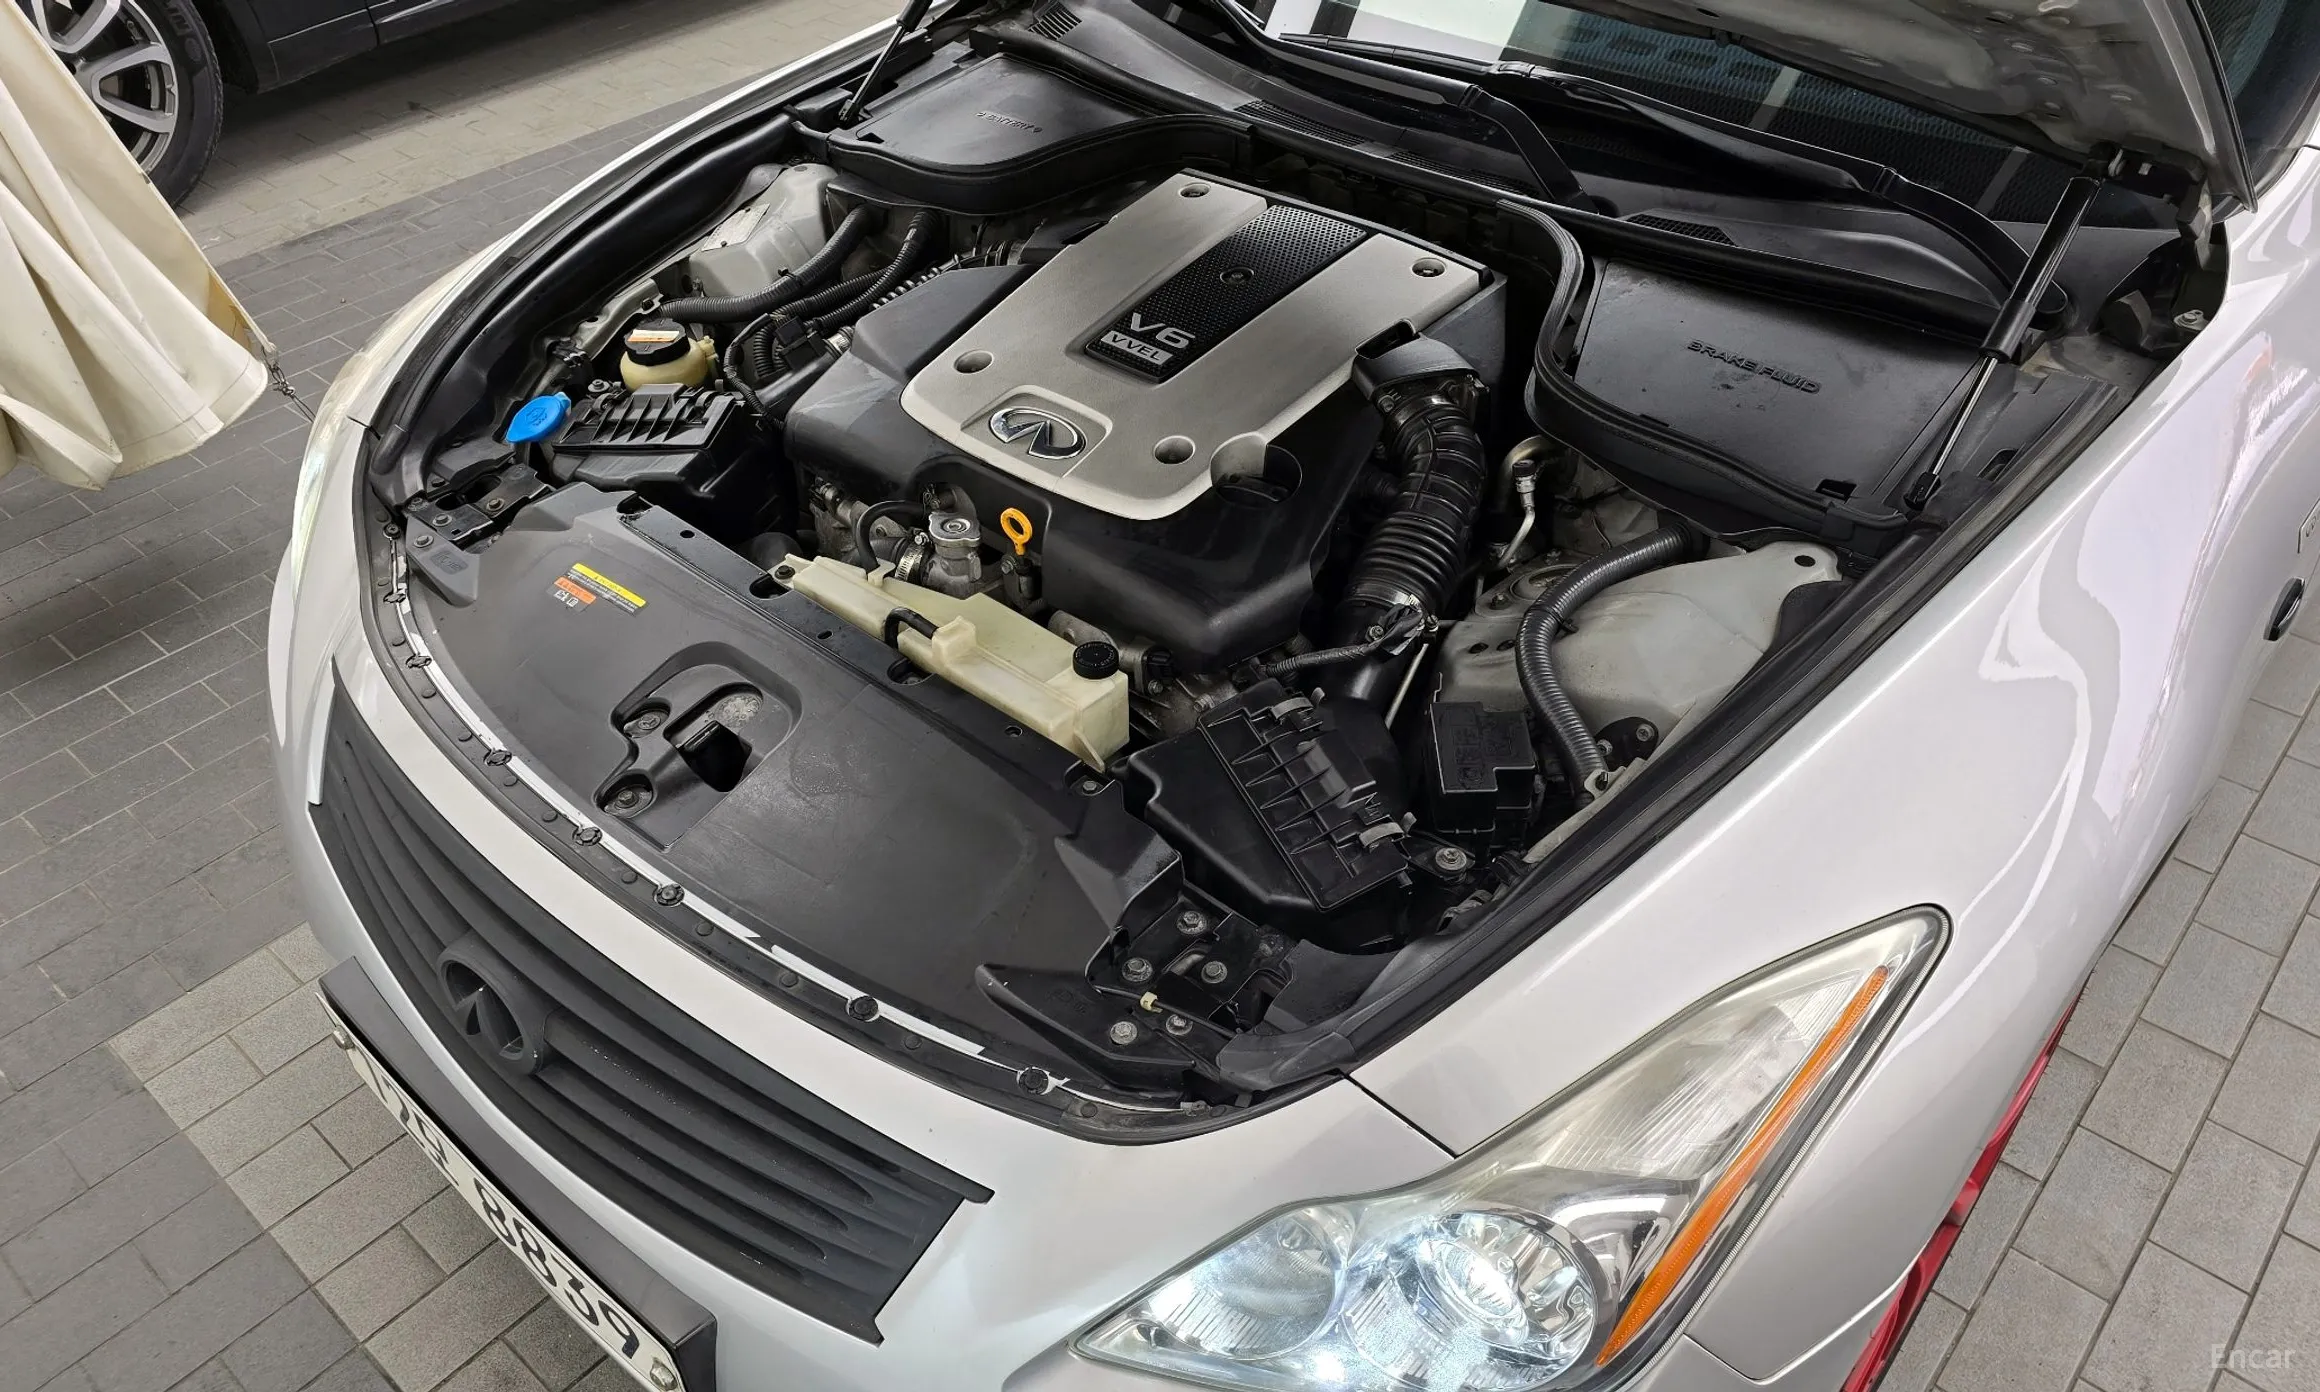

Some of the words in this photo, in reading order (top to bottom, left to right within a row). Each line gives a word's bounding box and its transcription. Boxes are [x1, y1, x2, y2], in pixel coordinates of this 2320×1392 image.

[1111, 333, 1161, 361] VVEL
[1130, 312, 1196, 349] V6
[1687, 339, 1757, 374] BRAKE
[1757, 364, 1822, 395] FLUID
[474, 1177, 641, 1360] 8839
